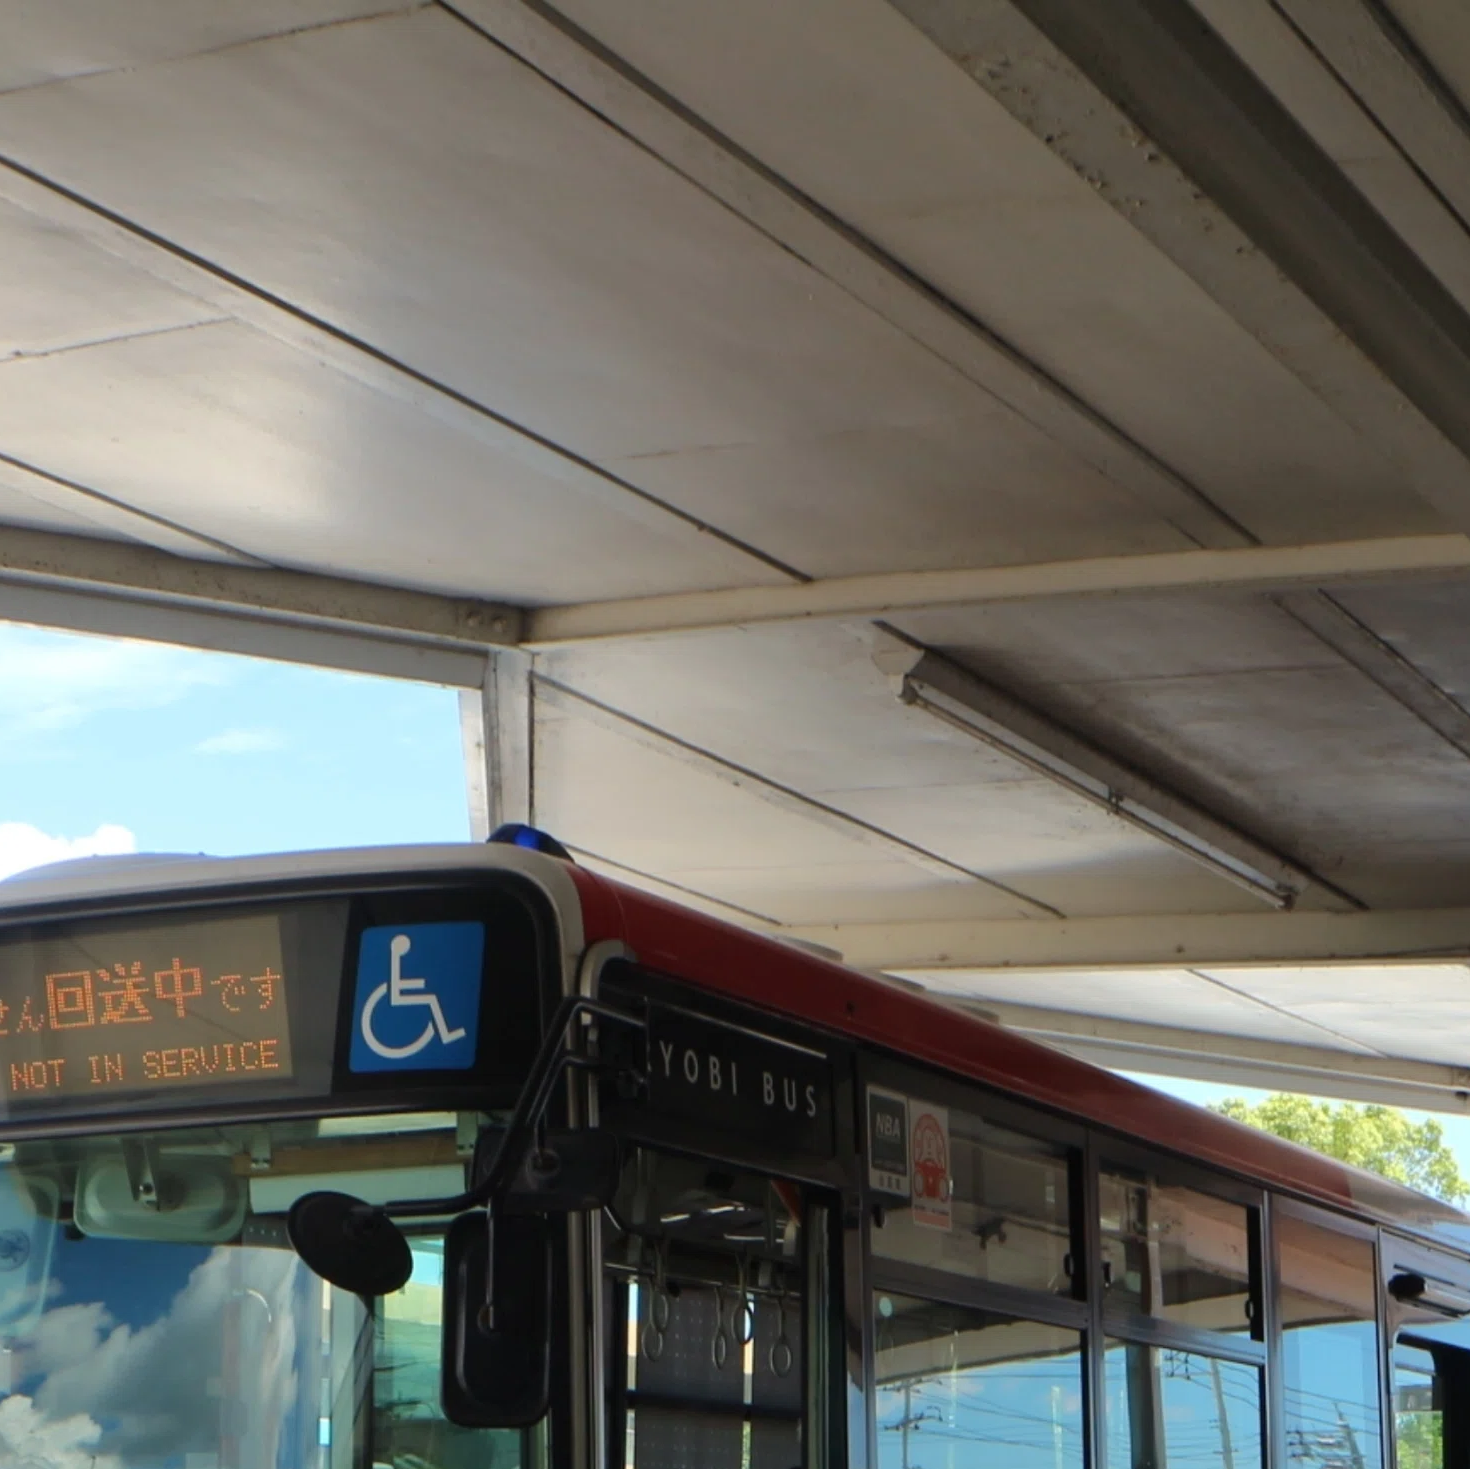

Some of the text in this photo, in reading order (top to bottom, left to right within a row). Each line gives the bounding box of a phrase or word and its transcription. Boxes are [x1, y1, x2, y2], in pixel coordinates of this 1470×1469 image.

[10, 1059, 65, 1091] NOT
[88, 1053, 124, 1084] IN
[143, 1039, 280, 1079] SERVICE
[647, 1040, 817, 1117] YOBI BUS
[875, 1111, 901, 1138] NBA
